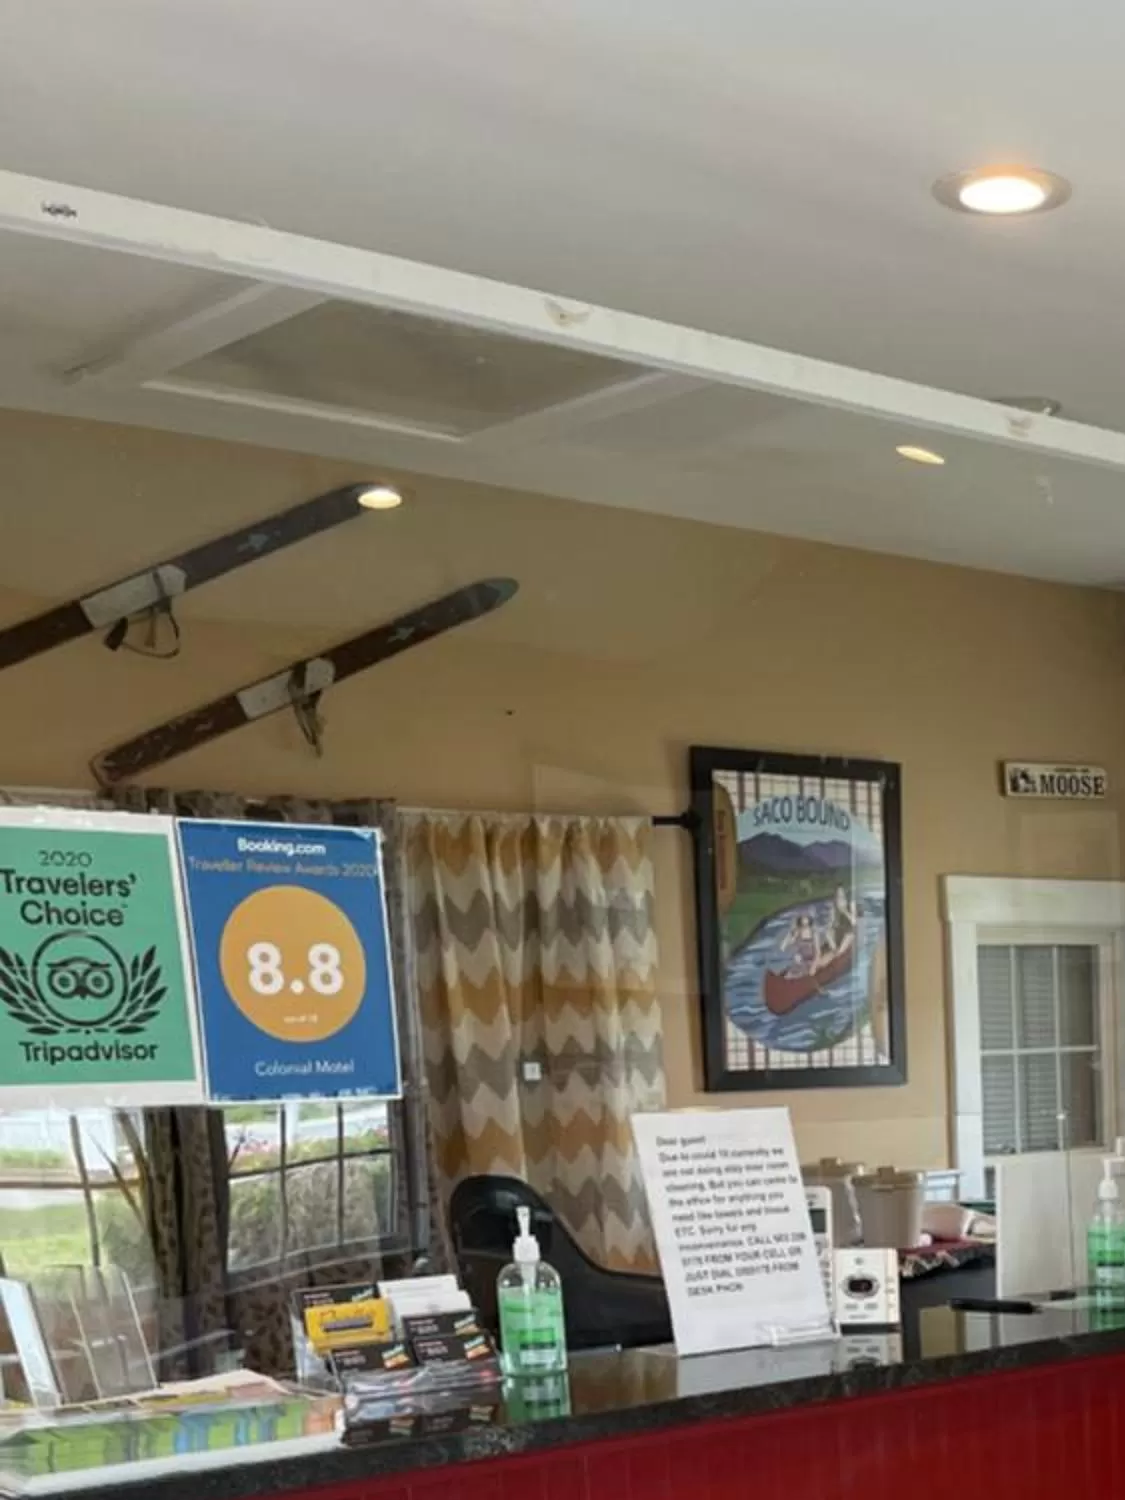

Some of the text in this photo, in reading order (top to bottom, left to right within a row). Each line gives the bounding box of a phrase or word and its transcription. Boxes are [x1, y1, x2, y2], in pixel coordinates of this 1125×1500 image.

[1040, 773, 1105, 796] MOOSE
[753, 795, 850, 831] SACO BOUND
[38, 849, 92, 868] 2020
[237, 837, 326, 857] Booking.com
[20, 899, 125, 927] Choice
[246, 940, 344, 996] 8.8
[19, 1040, 159, 1066] Tripadvisor
[254, 1059, 355, 1077] Colonial Motel
